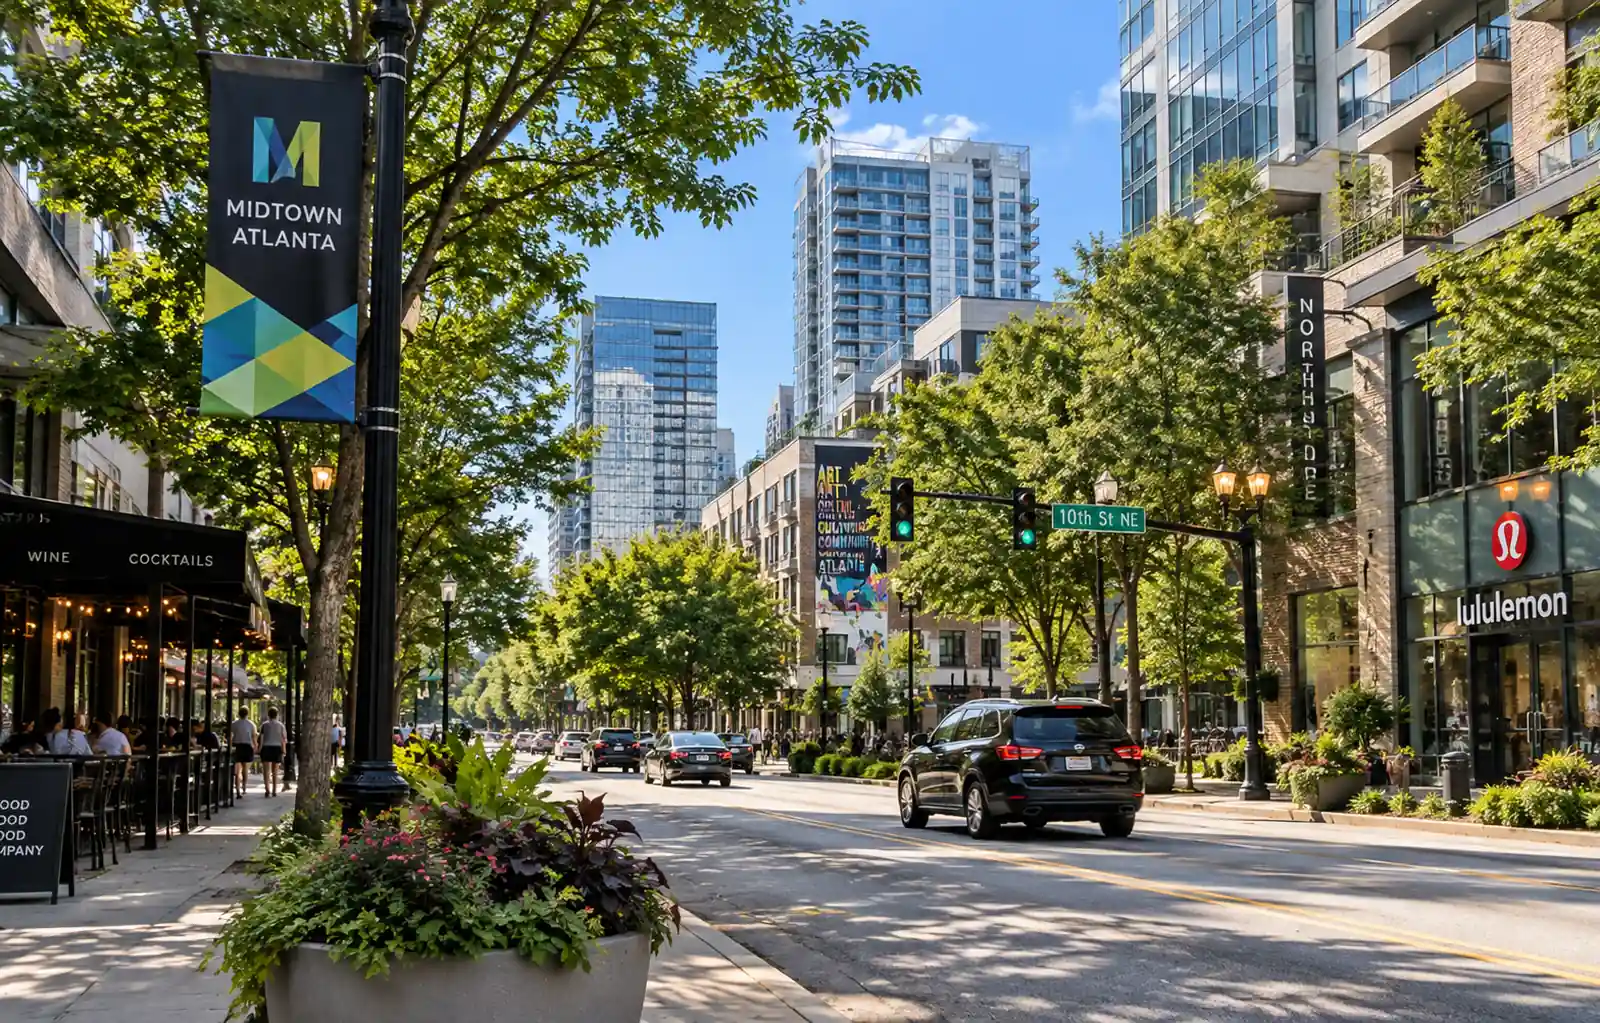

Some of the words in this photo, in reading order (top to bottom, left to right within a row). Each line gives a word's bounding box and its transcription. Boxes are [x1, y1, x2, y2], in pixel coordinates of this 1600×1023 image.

[226, 198, 343, 226] MIDTOWN
[232, 227, 337, 252] ATLANTA
[1060, 508, 1092, 526] 10th
[1098, 510, 1114, 527] St
[1120, 512, 1139, 528] NE
[27, 550, 70, 563] WINE
[129, 553, 214, 567] COCKTAILS
[1456, 590, 1568, 627] lululemon
